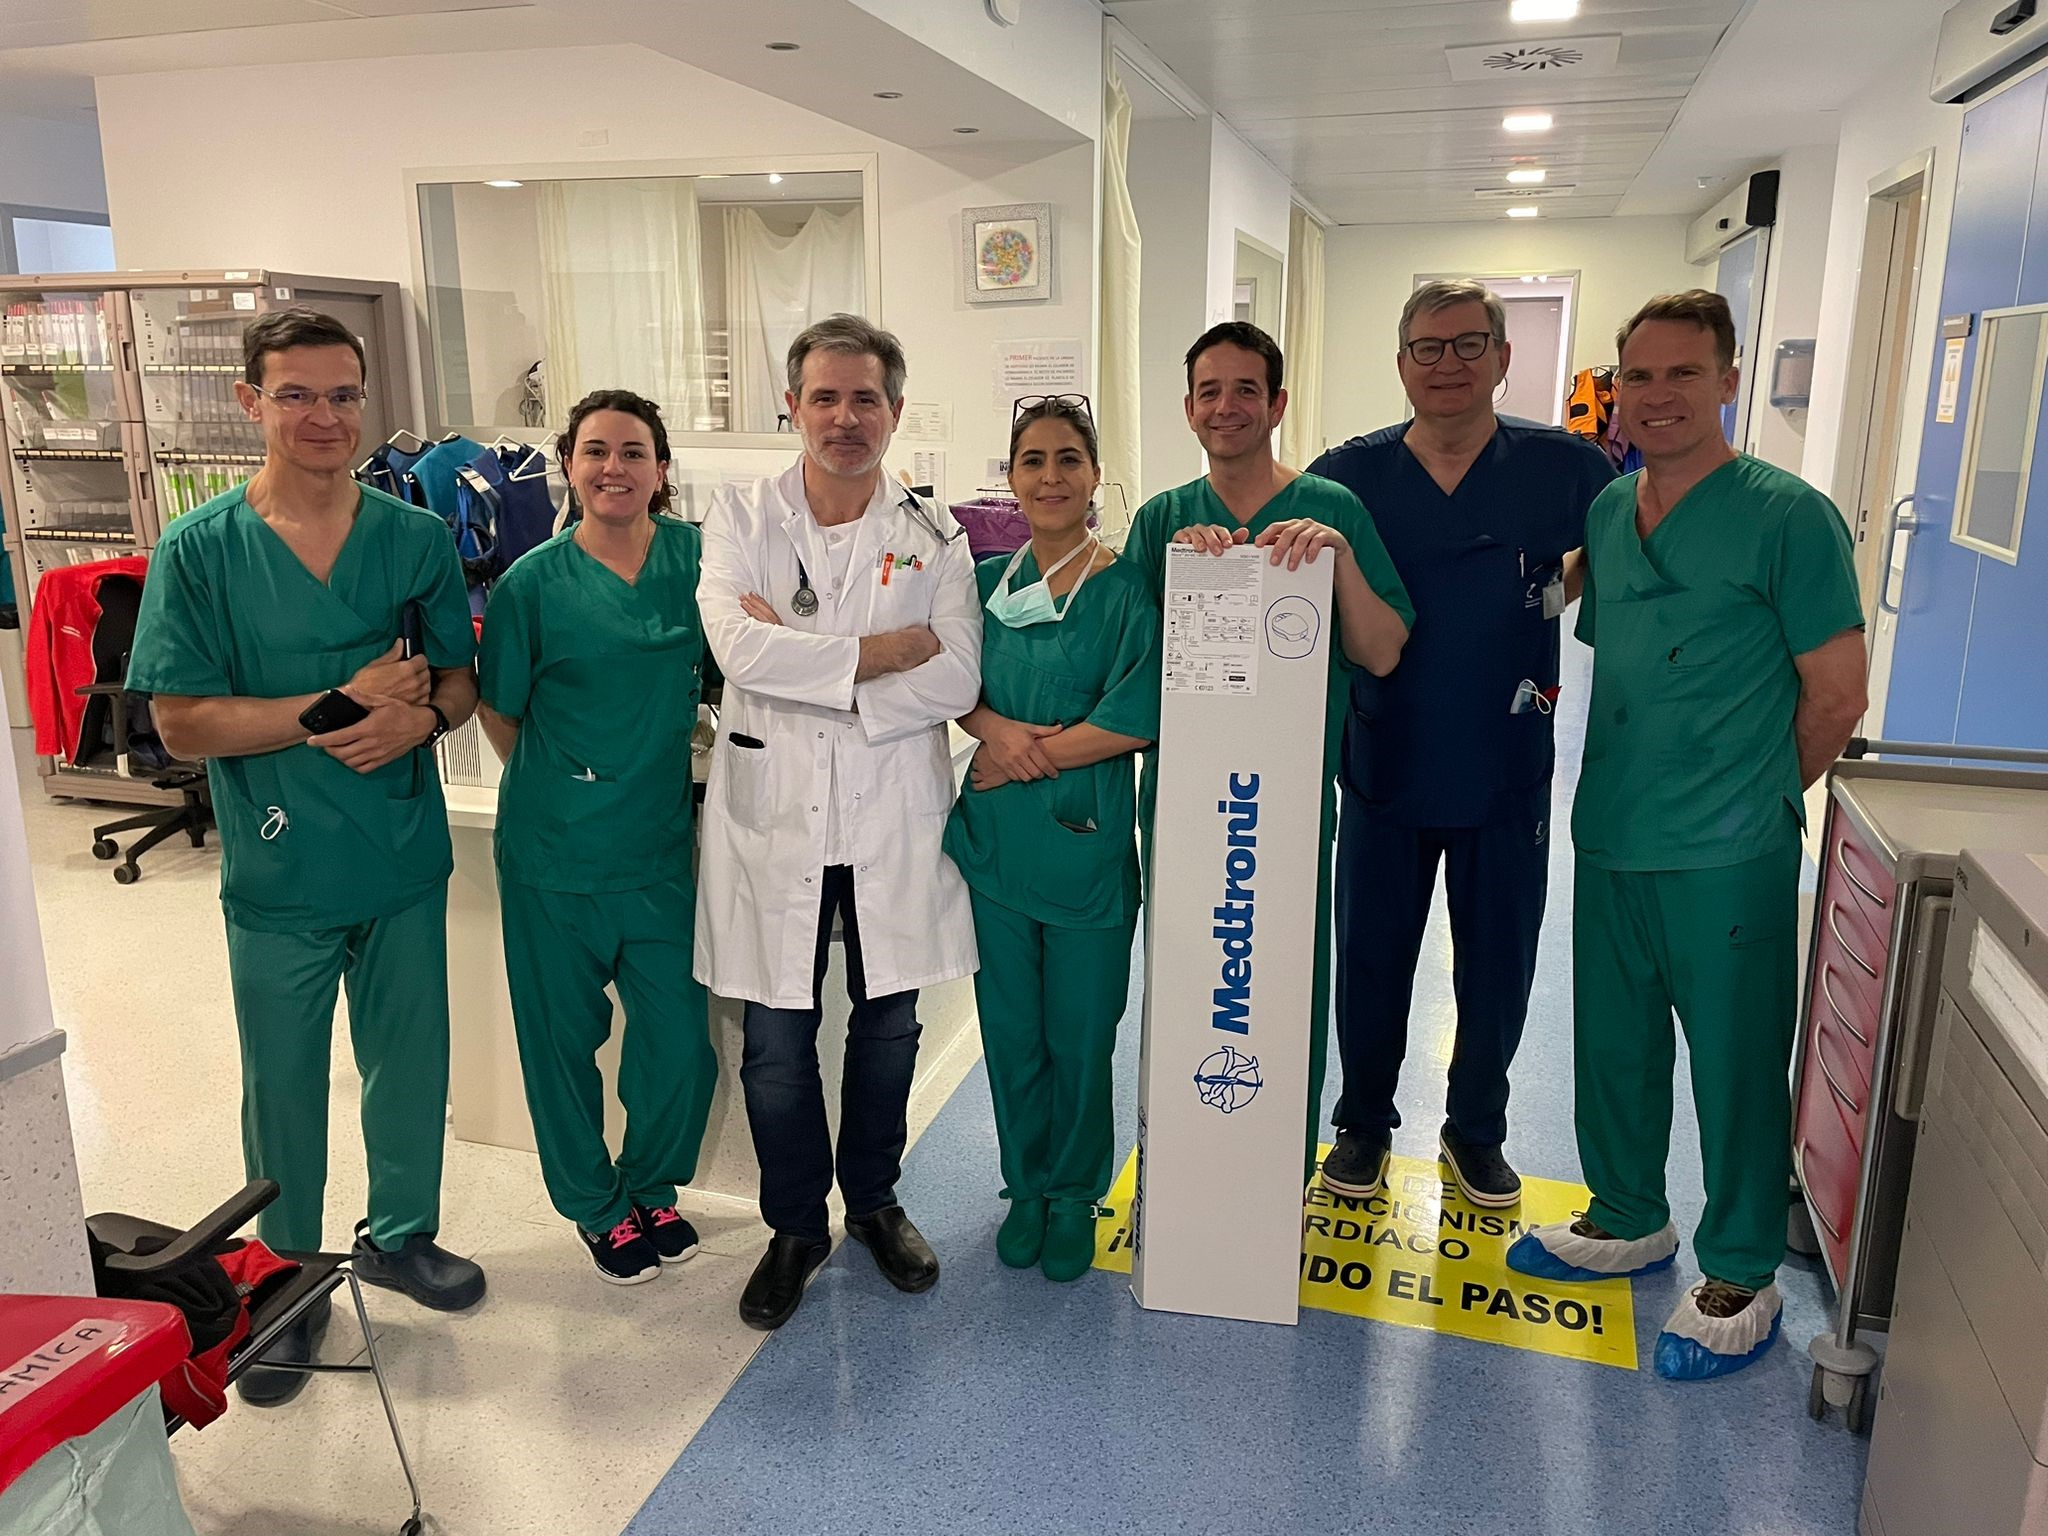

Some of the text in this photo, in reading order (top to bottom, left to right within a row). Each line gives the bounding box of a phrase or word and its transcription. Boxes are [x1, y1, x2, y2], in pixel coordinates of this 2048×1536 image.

[1212, 773, 1260, 1035] Medtronic
[1135, 1140, 1144, 1261] Medtronic
[1388, 1269, 1443, 1306] EL
[1461, 1281, 1604, 1335] PASO!
